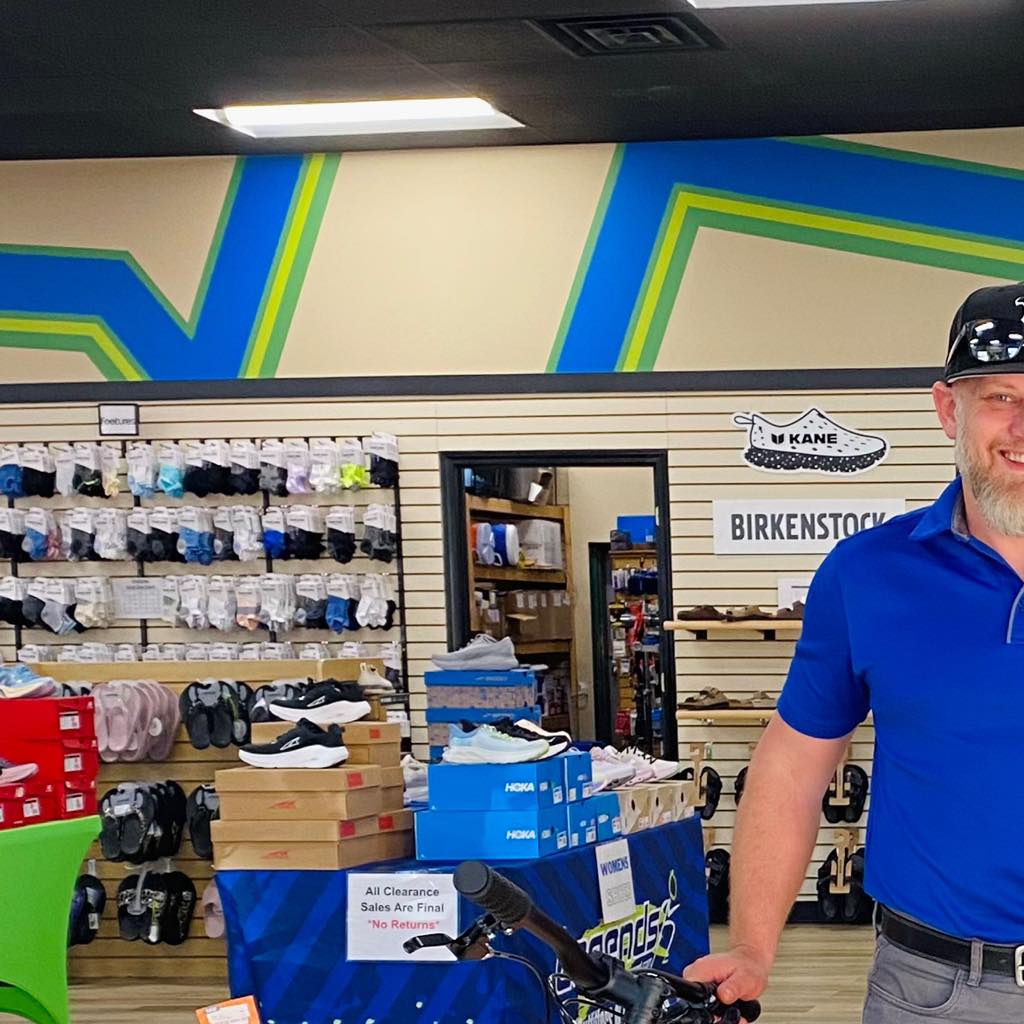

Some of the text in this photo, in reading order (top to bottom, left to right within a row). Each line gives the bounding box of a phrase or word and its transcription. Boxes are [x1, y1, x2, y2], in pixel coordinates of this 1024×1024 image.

[789, 433, 838, 444] KANE
[505, 782, 535, 793] HOKA
[506, 830, 536, 841] HOKA
[600, 856, 629, 876] WOMENS
[365, 886, 440, 897] All Clearance
[360, 902, 444, 913] Sales Are Final
